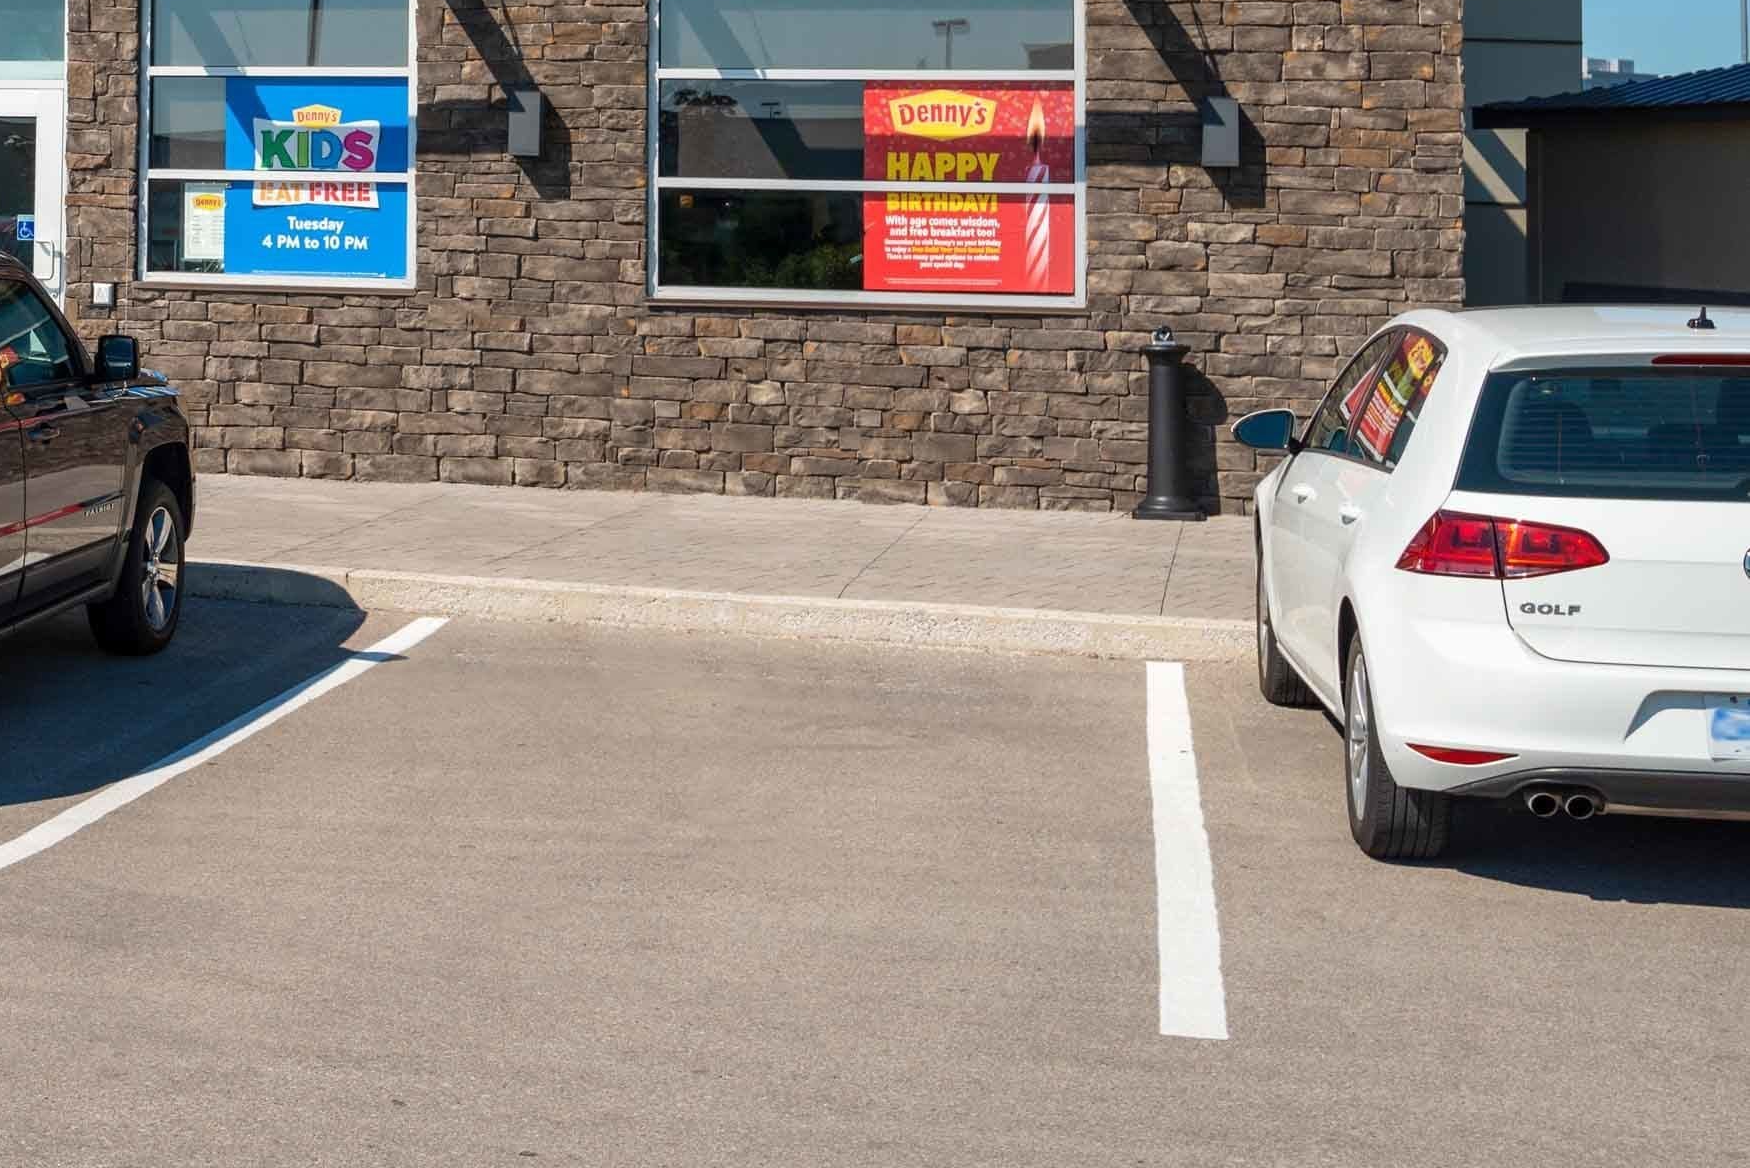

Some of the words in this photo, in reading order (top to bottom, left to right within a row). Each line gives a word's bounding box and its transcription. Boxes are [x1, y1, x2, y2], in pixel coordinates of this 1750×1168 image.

[297, 110, 338, 123] Denny's
[898, 101, 987, 127] Denny's
[261, 129, 374, 171] KIDS
[887, 151, 1000, 181] HAPPY
[260, 182, 304, 201] EAT
[308, 182, 371, 202] FREE
[886, 193, 998, 213] BIRTHDAY!
[287, 216, 345, 234] Tuesday
[885, 216, 907, 225] With
[909, 218, 927, 227] age
[929, 218, 958, 226] comes
[960, 216, 1000, 228] wisdom,
[890, 227, 908, 236] and
[909, 227, 928, 236] free
[930, 227, 975, 237] breakfast
[262, 235, 273, 248] 4
[277, 235, 300, 249] PM
[304, 237, 320, 249] to
[323, 236, 340, 250] 10
[344, 236, 369, 250] PM
[1519, 601, 1582, 617] GOLF
